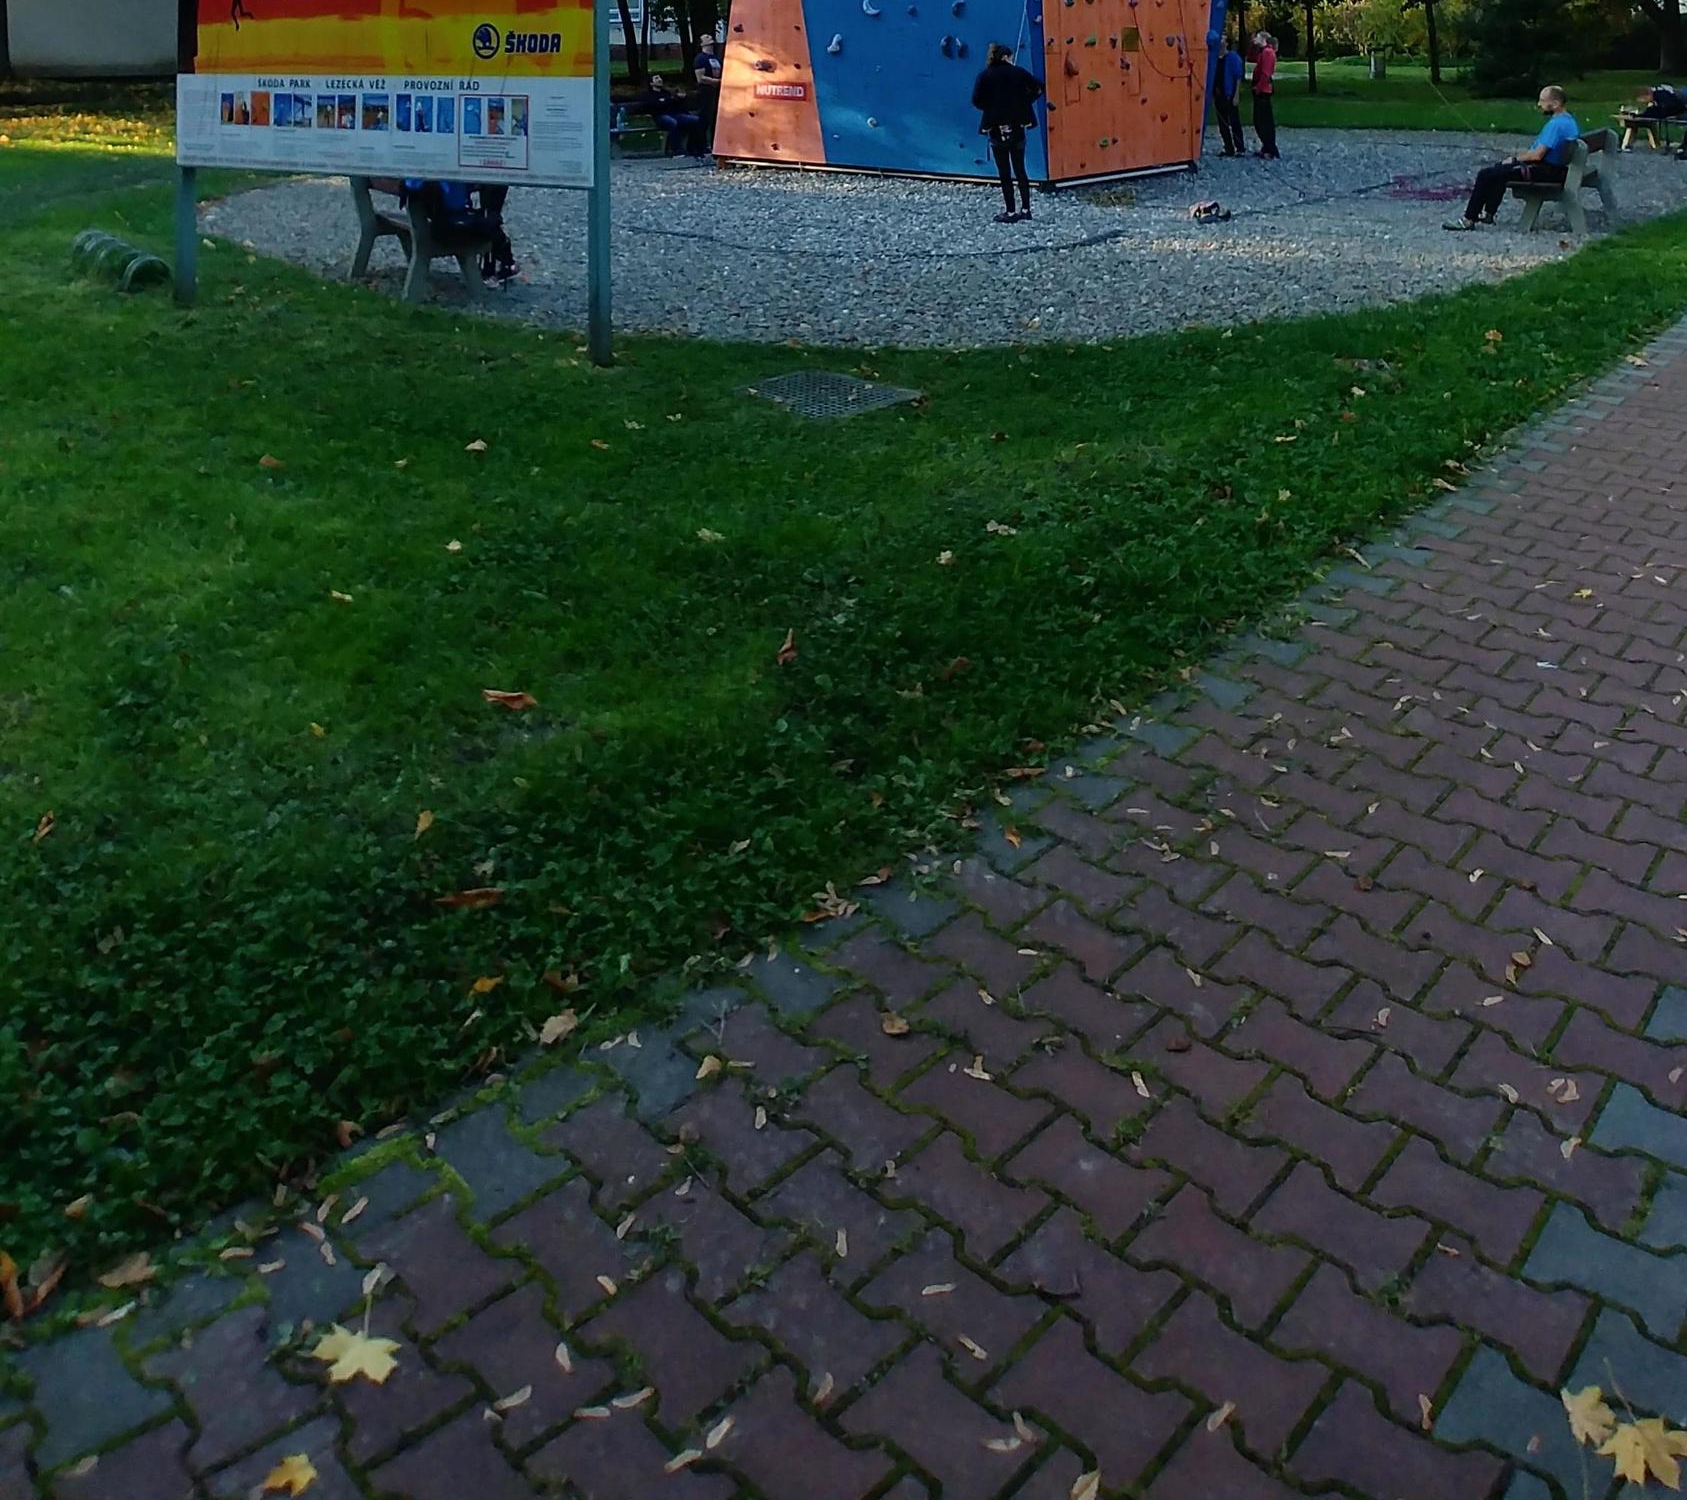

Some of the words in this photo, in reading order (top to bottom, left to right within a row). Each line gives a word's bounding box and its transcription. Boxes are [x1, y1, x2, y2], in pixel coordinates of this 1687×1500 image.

[504, 30, 562, 53] ŠKODA
[257, 78, 285, 88] ŠKODA
[289, 79, 311, 88] PARK
[325, 78, 364, 89] LEZECKÁ
[404, 79, 454, 90] PROVOZNÍ
[756, 84, 805, 97] NUTREND
